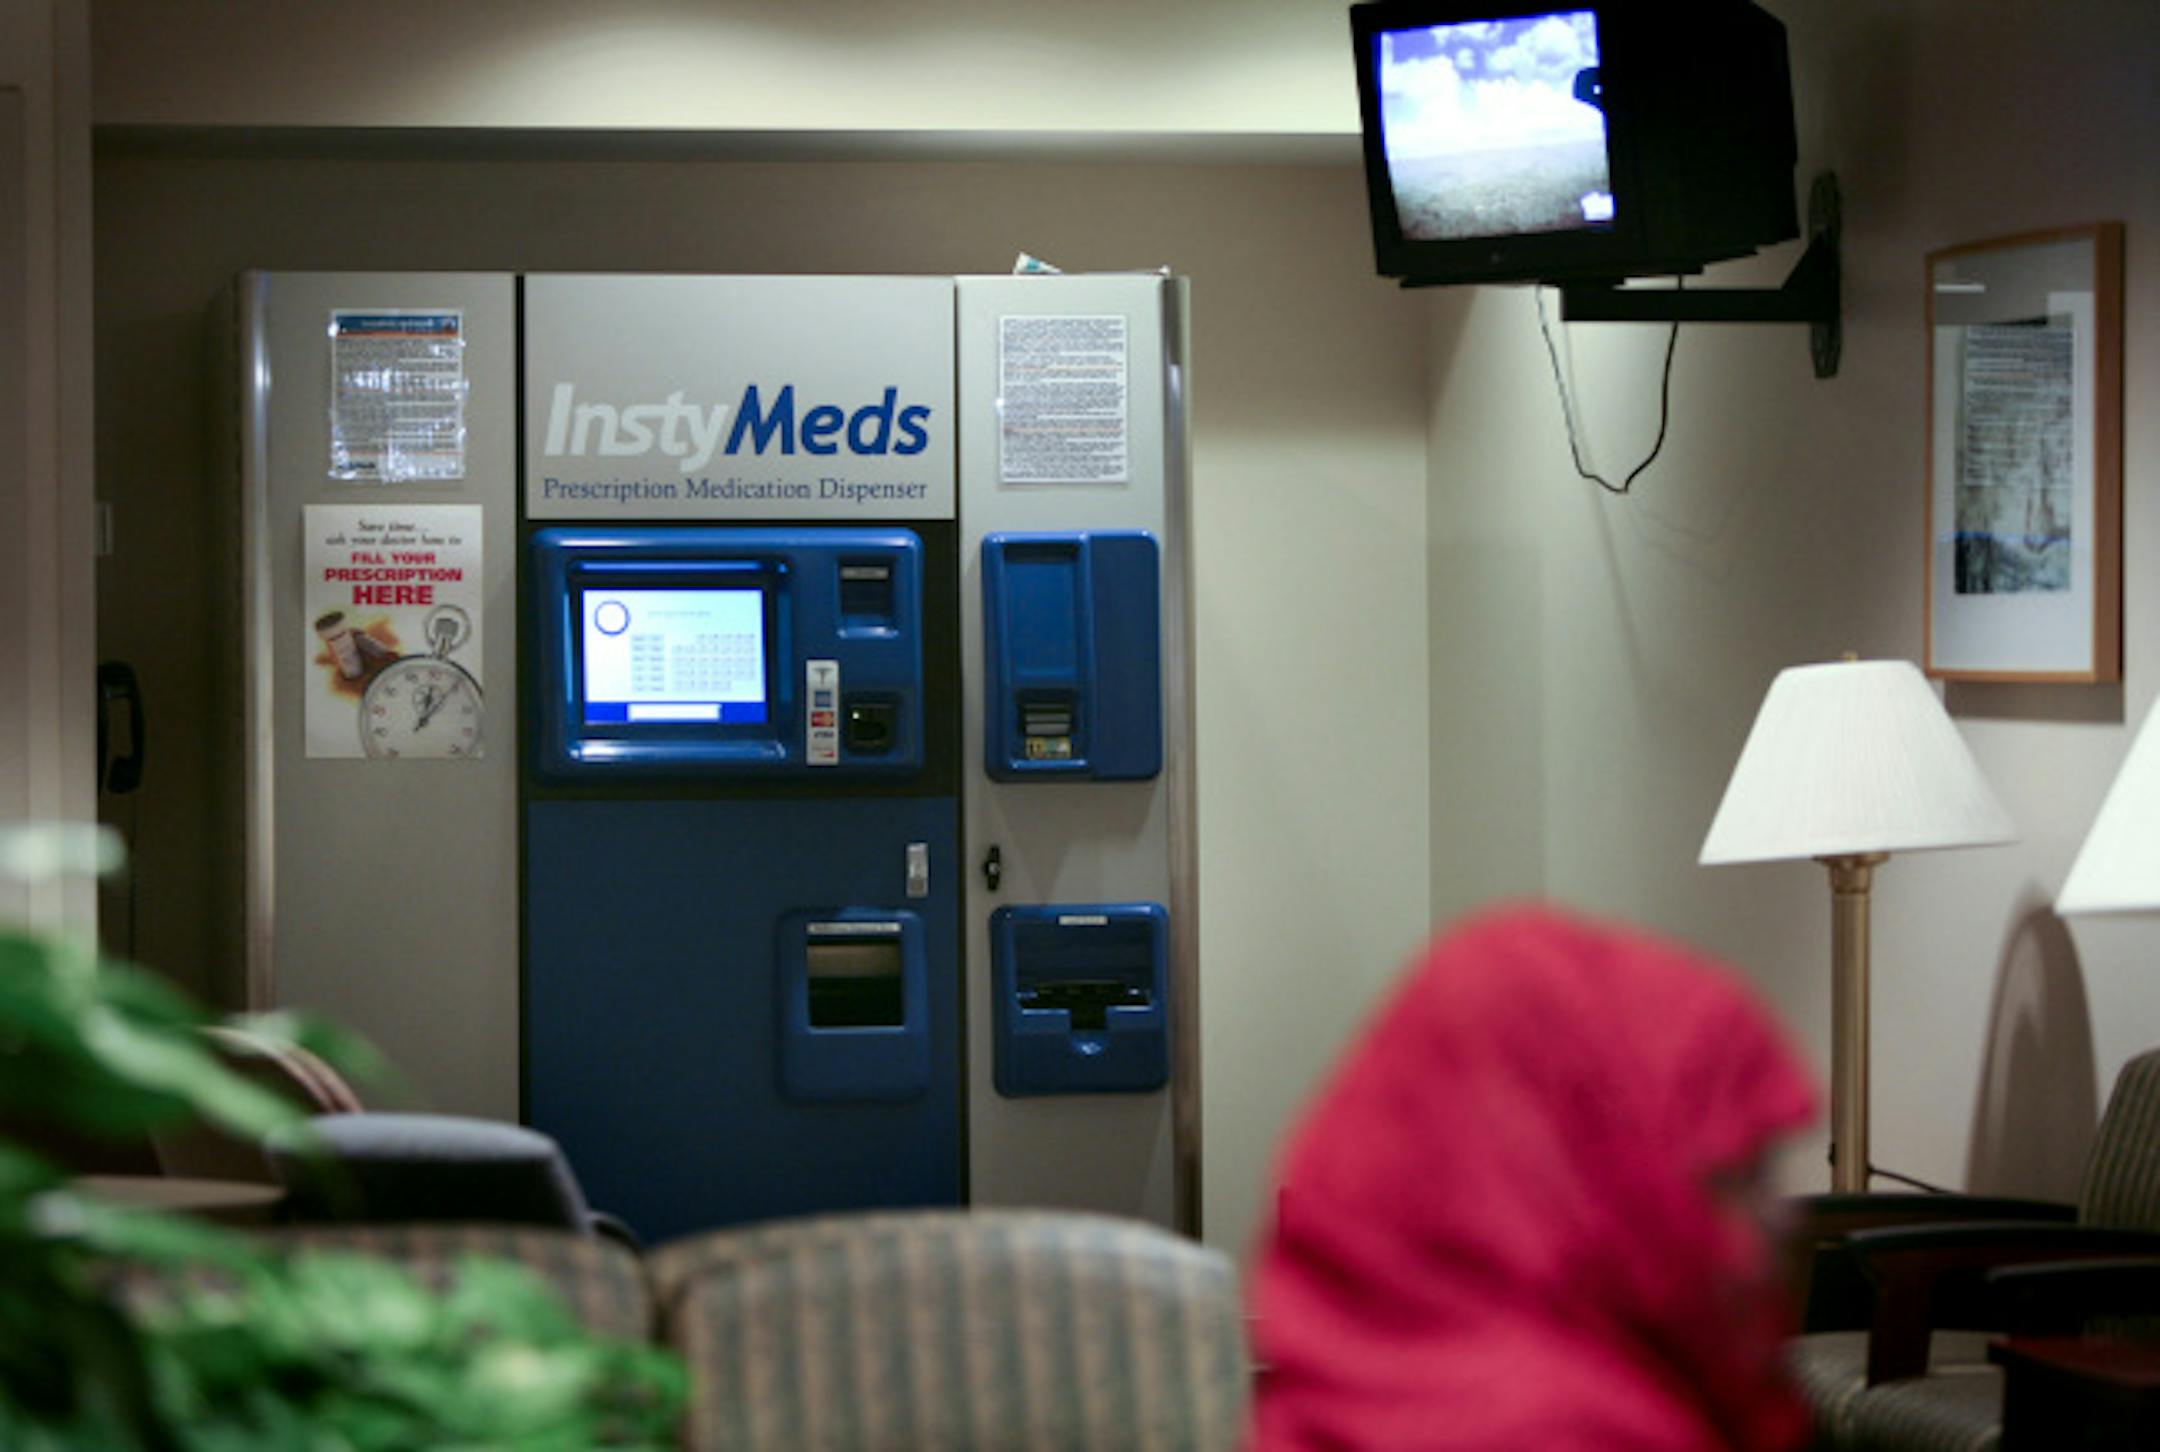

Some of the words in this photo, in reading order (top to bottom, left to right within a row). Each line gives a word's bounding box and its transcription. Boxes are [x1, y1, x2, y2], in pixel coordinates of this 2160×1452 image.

[543, 383, 932, 473] InstyMeds
[543, 477, 677, 503] Prescription
[686, 477, 811, 499] Medication
[818, 477, 928, 503] Dispenser
[351, 552, 385, 565] FILL
[391, 552, 436, 565] YOUR
[324, 568, 463, 582] PRESCRIPTION
[352, 584, 434, 605] HERE
